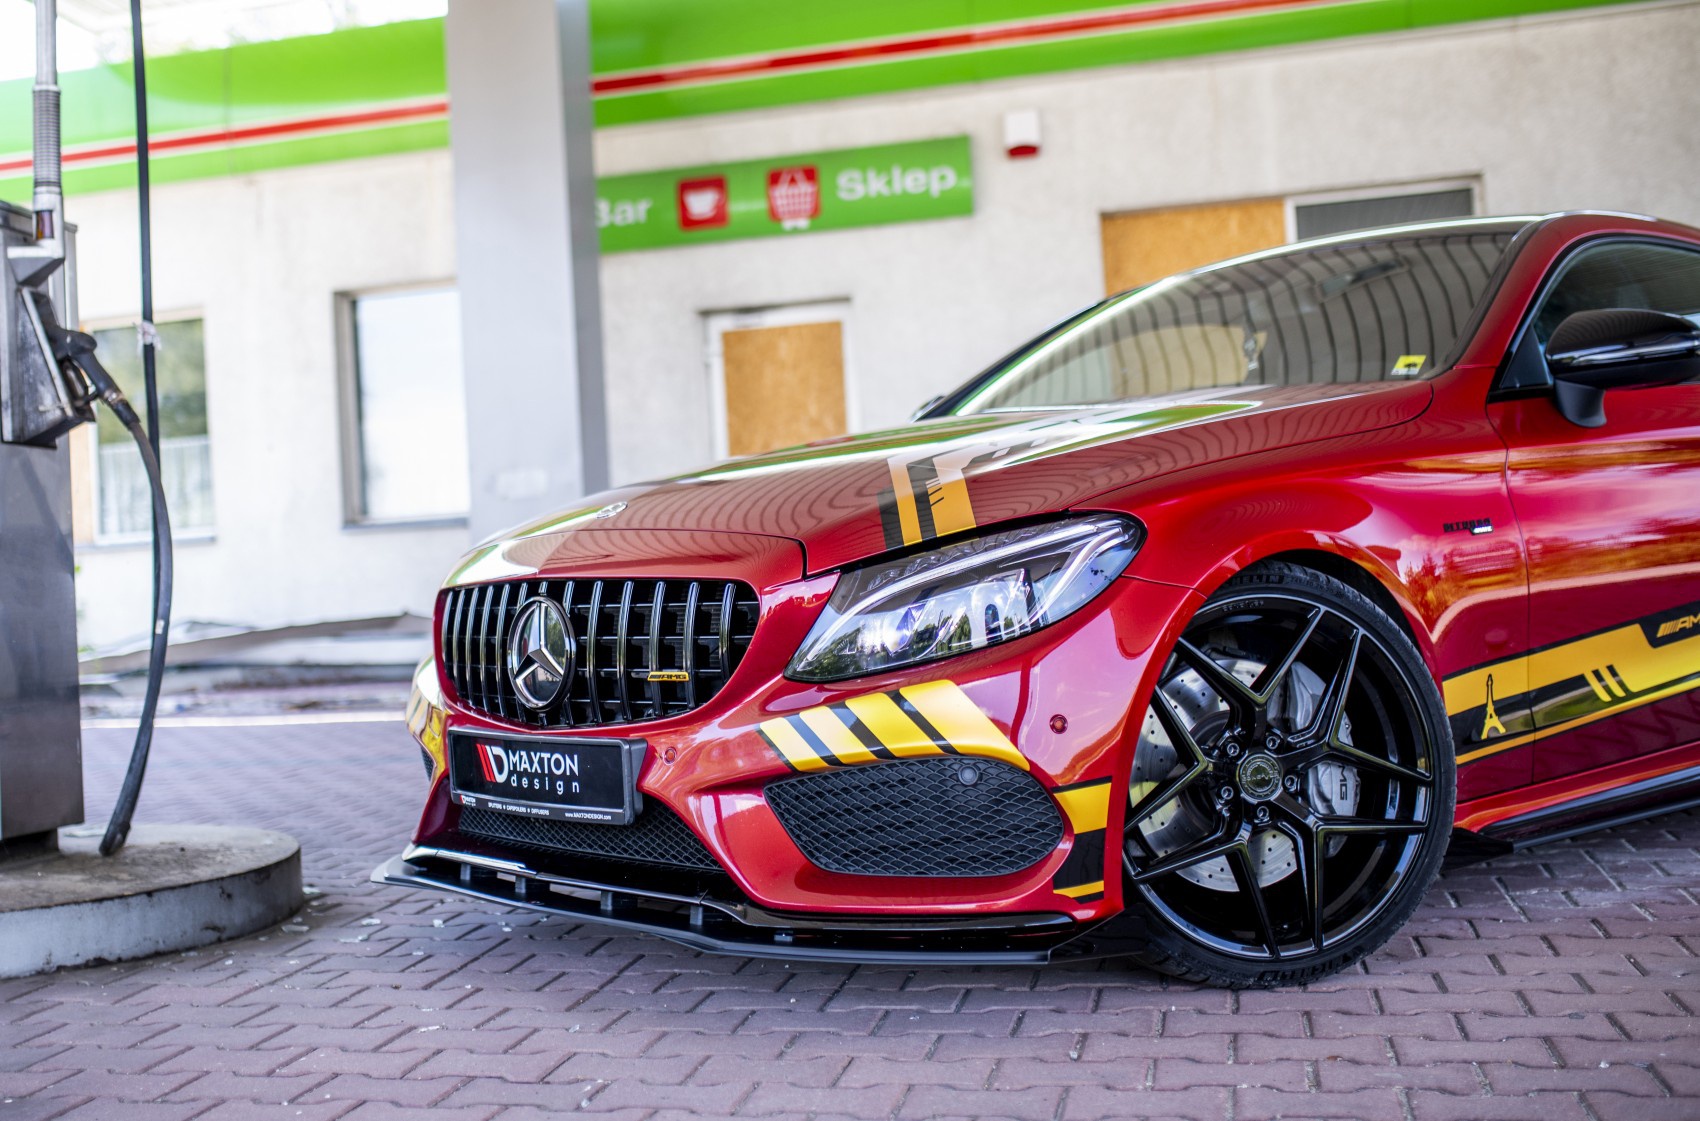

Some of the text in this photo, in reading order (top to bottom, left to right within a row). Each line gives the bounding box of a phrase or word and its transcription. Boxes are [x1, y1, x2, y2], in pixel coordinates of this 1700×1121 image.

[836, 165, 957, 201] Sklep
[508, 750, 579, 776] MAXTON
[510, 774, 580, 795] design
[1337, 764, 1348, 801] MG
